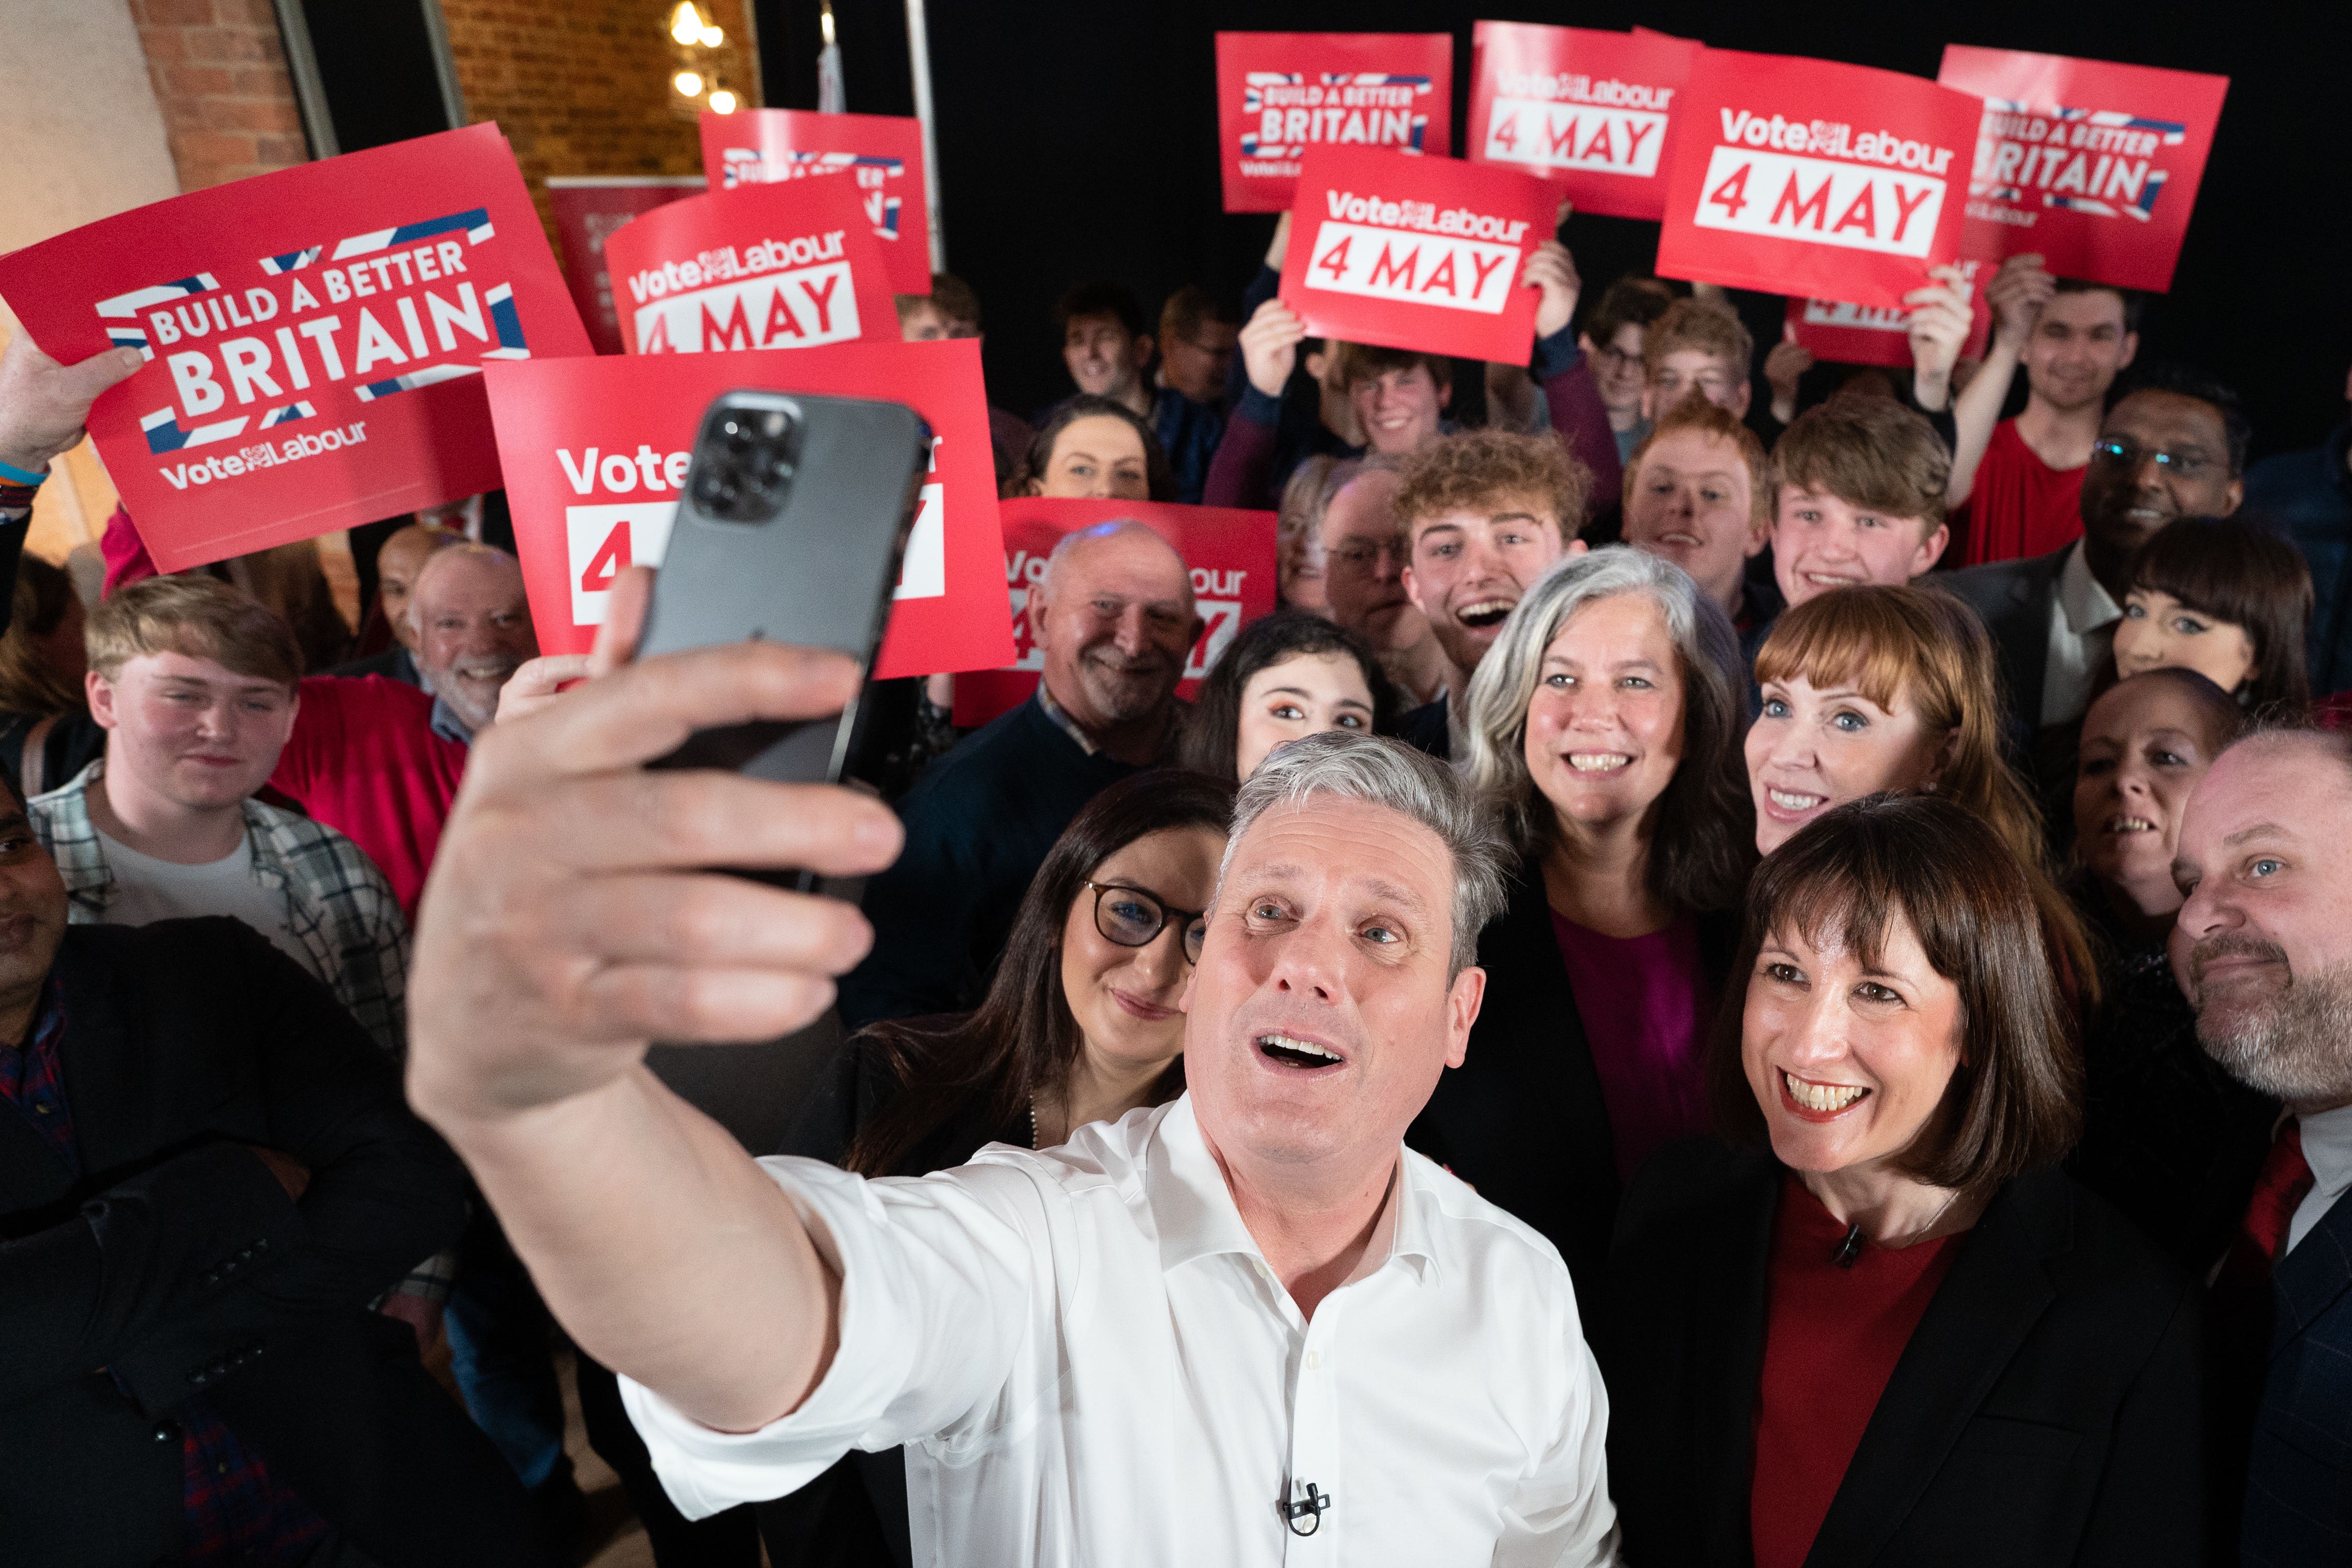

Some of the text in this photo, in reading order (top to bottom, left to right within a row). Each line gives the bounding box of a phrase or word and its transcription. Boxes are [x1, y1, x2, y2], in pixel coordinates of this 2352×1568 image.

[1265, 85, 1413, 107] BUILD A BETTER
[1499, 72, 1673, 109] Vote Labour
[1261, 108, 1412, 144] BRITAIN
[1495, 110, 1655, 165] 4 MAY
[1720, 108, 1954, 174] Vote Labour
[2047, 122, 2066, 145] A
[2071, 124, 2159, 156] BETTER
[1709, 162, 1931, 242] 4 MAY
[1973, 138, 2149, 201] BRITAIN
[1327, 190, 1530, 241] Vote Labour
[150, 241, 467, 345] BUILD A BETTER
[628, 231, 846, 303] Vote Labour
[1319, 235, 1506, 300] 4 MAY
[701, 273, 839, 351] MAY
[167, 282, 490, 418] BRITAIN
[160, 421, 367, 490] Vote Labour
[556, 445, 692, 495] Vote
[581, 522, 631, 591] 4
